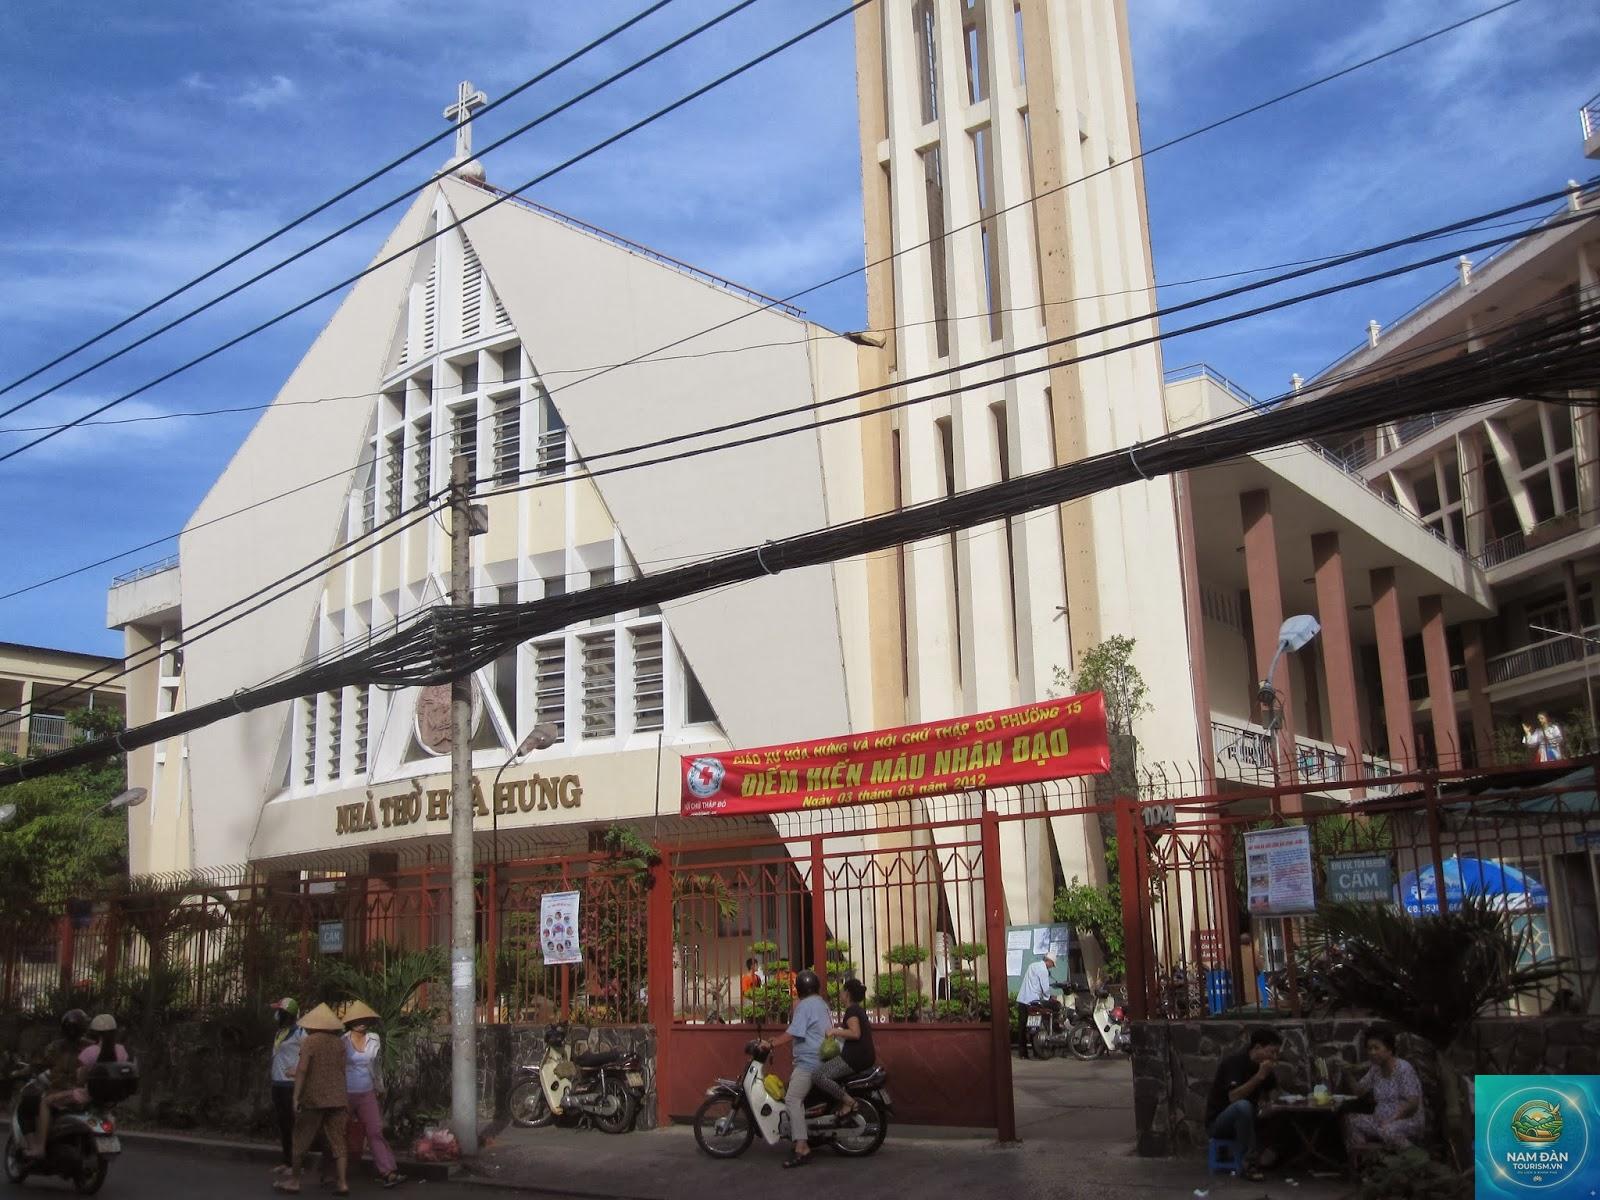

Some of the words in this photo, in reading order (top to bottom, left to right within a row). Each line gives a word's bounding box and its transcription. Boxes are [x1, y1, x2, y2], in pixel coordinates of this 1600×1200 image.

[853, 737, 870, 751] VÀ
[935, 722, 970, 741] THẬP
[1065, 700, 1082, 715] 15
[806, 758, 864, 792] HIẾN
[870, 754, 926, 785] MÁU
[933, 740, 1004, 777] NHÂN
[1012, 727, 1069, 766] ĐẠO
[335, 789, 378, 836] NHÀ
[380, 778, 424, 828] THỜ
[426, 775, 490, 822] HÀ
[493, 772, 583, 815] HƯNG
[802, 795, 834, 809] Ngày
[837, 791, 854, 803] 03
[858, 787, 893, 803] tháng
[899, 785, 915, 797] 03
[918, 781, 947, 795] năm
[954, 773, 987, 788] 2012
[1141, 804, 1176, 827] 104
